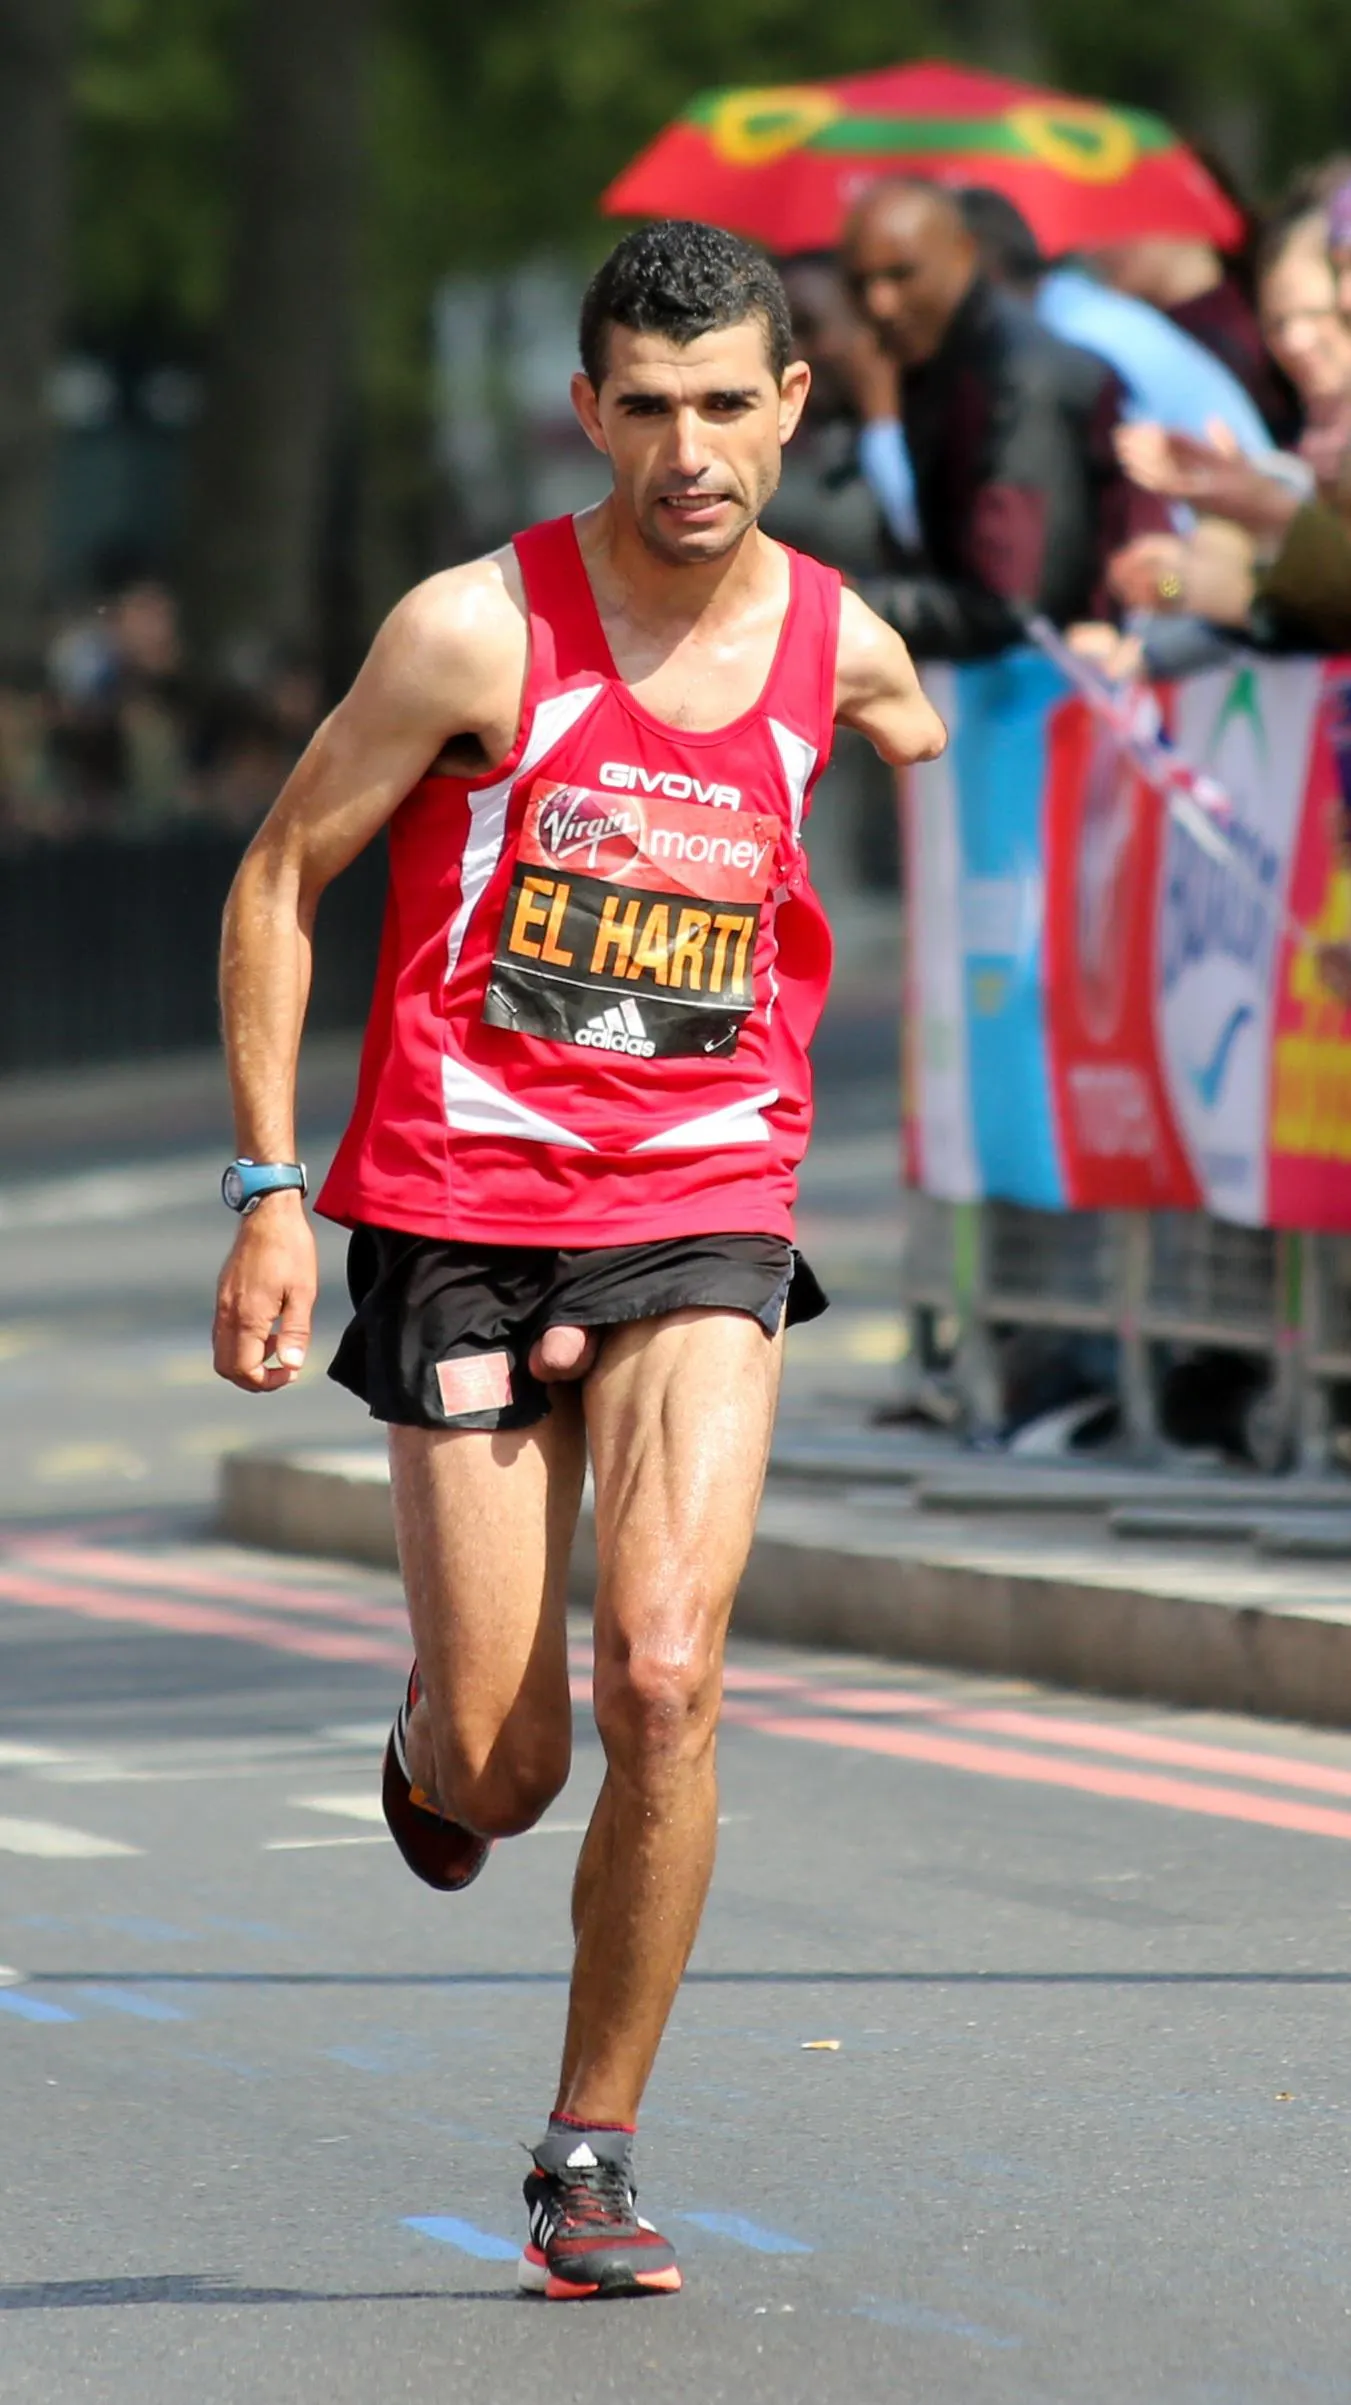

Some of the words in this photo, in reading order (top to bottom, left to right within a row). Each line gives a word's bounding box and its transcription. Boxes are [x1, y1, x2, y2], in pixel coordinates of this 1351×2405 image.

[599, 762, 741, 812] GIVOVA
[542, 788, 639, 869] Virgin
[650, 828, 770, 878] money
[507, 875, 573, 967] EL
[590, 895, 755, 994] HARTI
[574, 1024, 656, 1058] adidas
